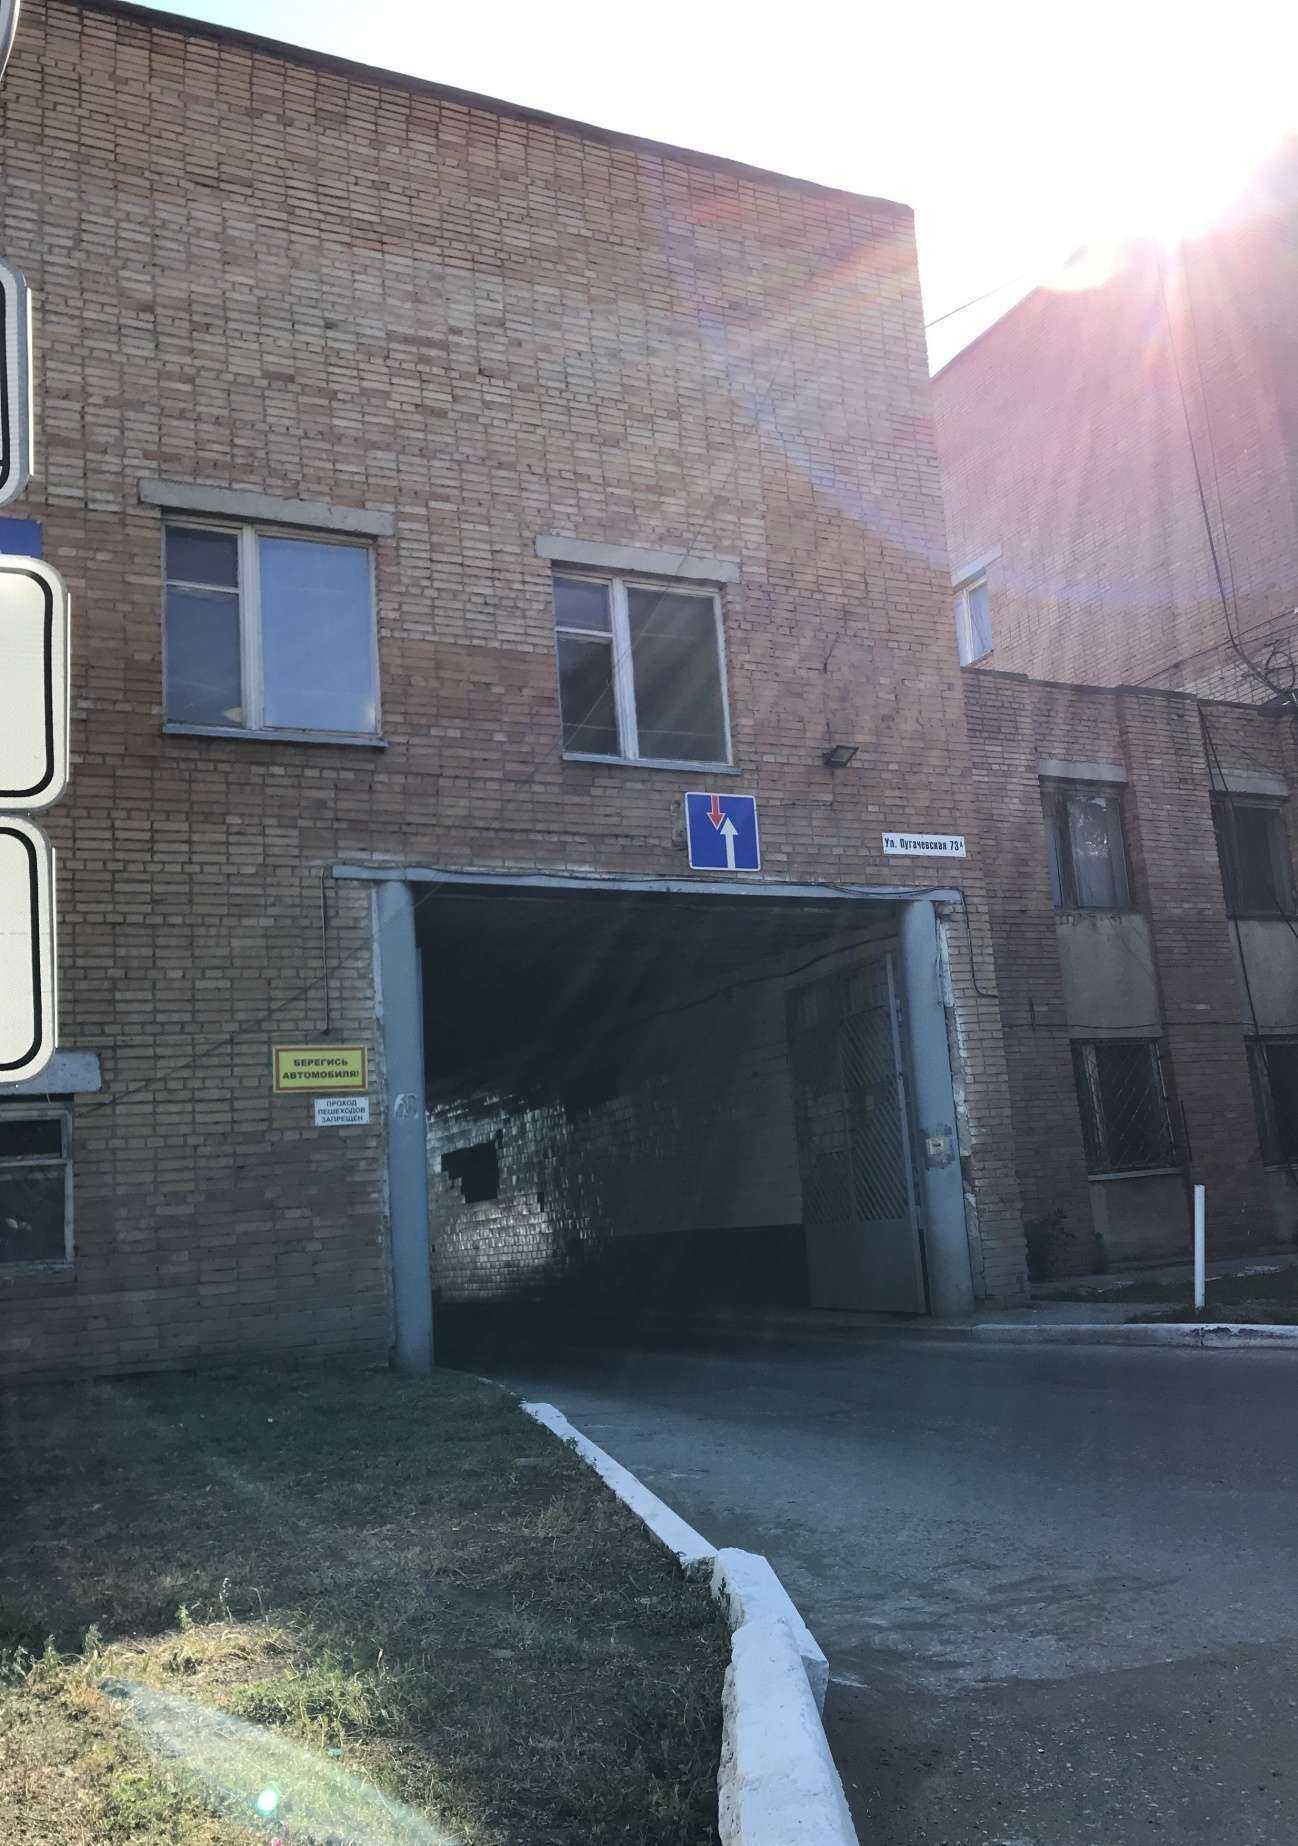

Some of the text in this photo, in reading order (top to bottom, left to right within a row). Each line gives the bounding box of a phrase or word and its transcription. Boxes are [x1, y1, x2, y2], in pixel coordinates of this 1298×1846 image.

[884, 838, 897, 848] Ул.
[900, 838, 947, 850] Пугачевская
[293, 1058, 348, 1067] БЕРЕГИСЬ
[282, 1070, 359, 1079] АВТОМОБИЛЯ!
[326, 1099, 357, 1107] ПРОХОД
[318, 1107, 365, 1115] ПЕШЕХОДОВ
